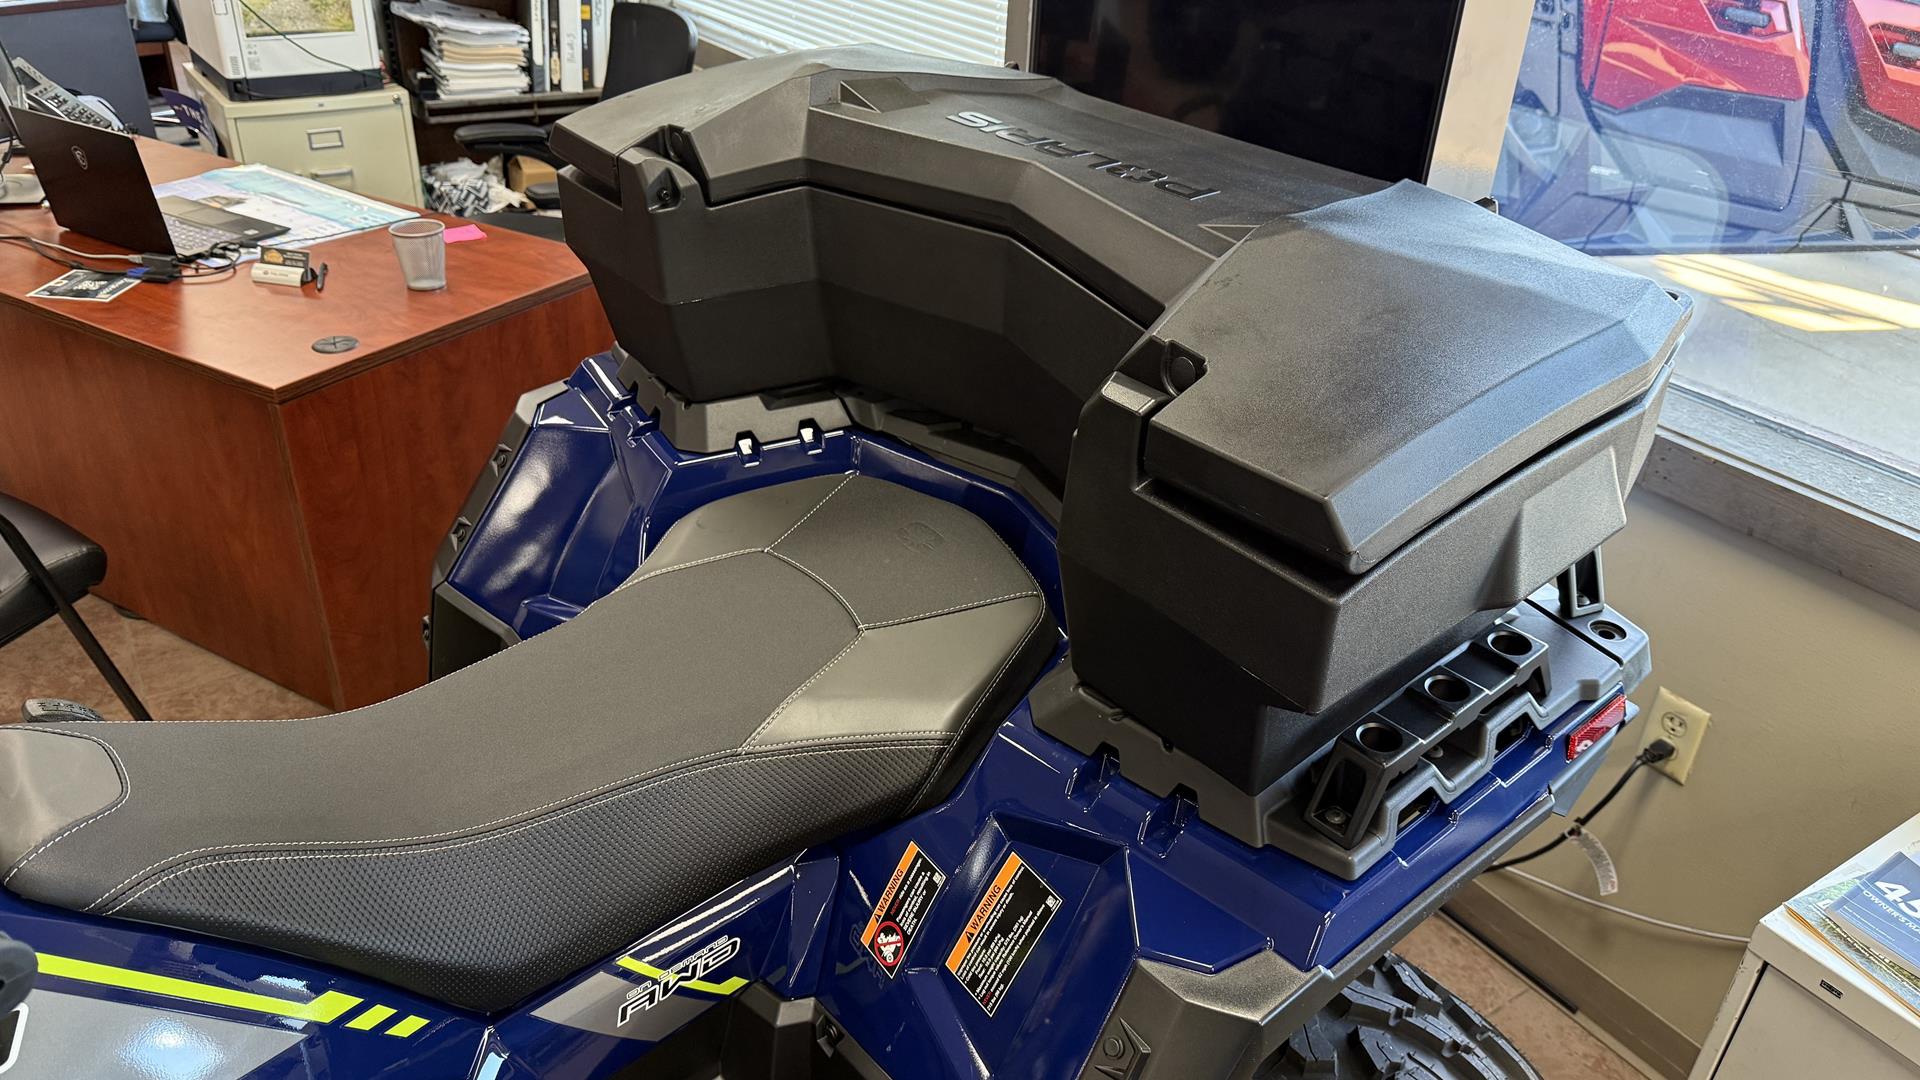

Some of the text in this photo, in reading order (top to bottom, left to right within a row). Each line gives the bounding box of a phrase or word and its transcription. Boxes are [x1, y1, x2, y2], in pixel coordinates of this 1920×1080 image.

[946, 111, 1221, 200] POLARIS
[878, 868, 904, 914] WARNING
[971, 884, 1001, 931] WARNING
[1863, 890, 1908, 923] OWNER'S
[617, 937, 741, 1027] AWD
